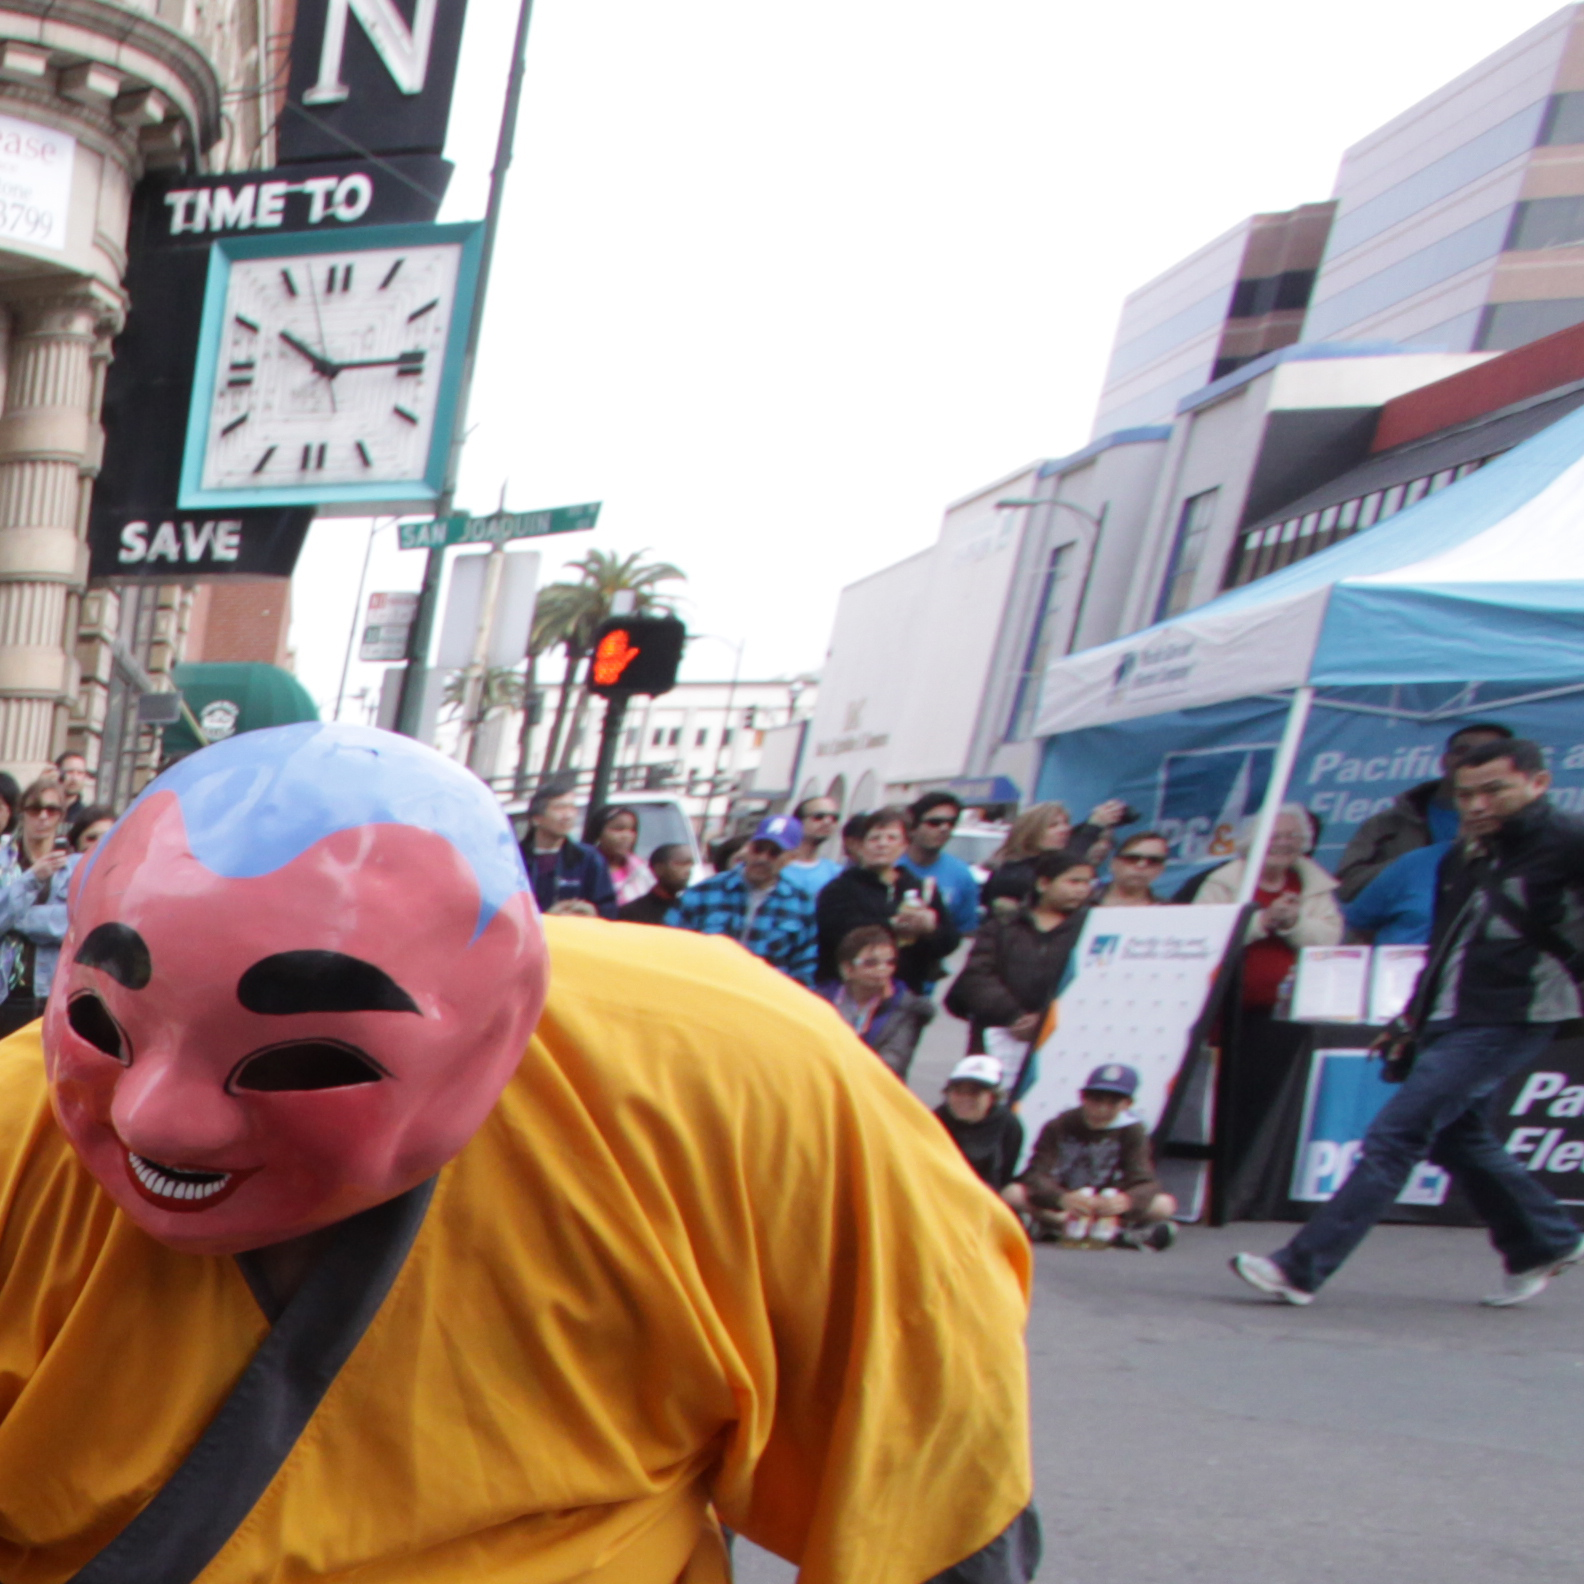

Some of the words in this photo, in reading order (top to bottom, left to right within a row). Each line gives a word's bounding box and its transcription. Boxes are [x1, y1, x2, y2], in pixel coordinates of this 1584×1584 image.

[302, 0, 438, 105] N
[164, 181, 289, 235] TIME
[301, 172, 374, 224] TO
[118, 520, 242, 563] SAVE
[401, 520, 448, 548] SAN
[457, 510, 553, 543] JOAQUIN
[1503, 1126, 1584, 1174] Ele
